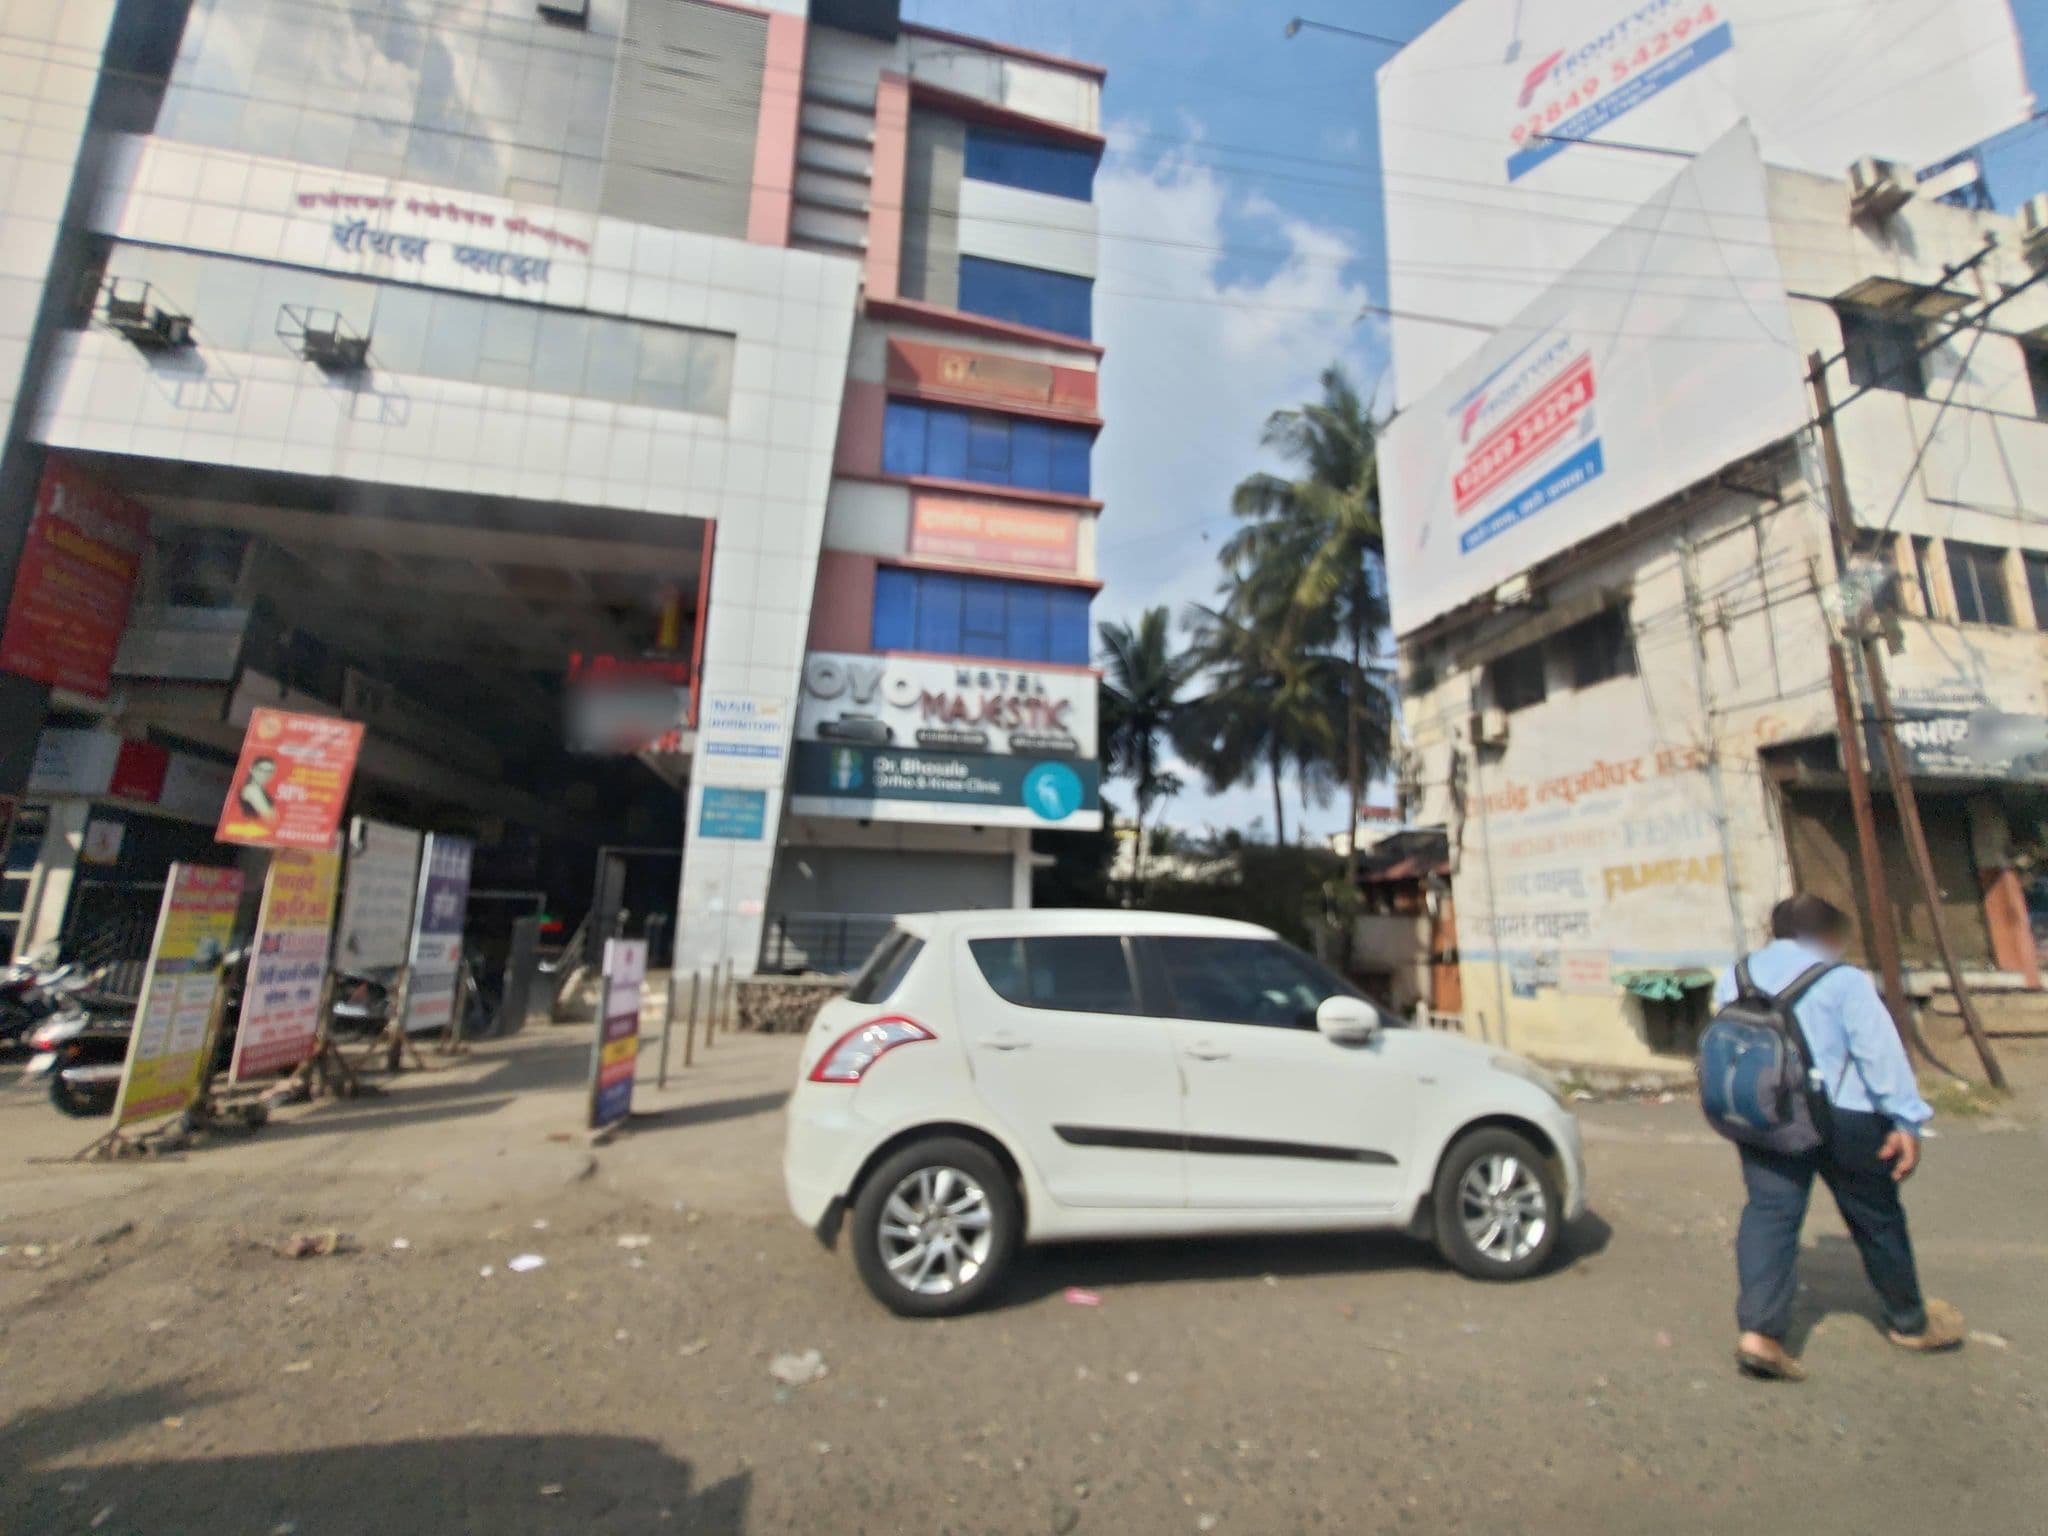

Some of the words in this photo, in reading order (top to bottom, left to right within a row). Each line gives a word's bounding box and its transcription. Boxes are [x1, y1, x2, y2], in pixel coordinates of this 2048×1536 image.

[1510, 76, 1600, 144] 92849
[1611, 3, 1716, 82] 54294
[805, 660, 922, 708] OYO
[955, 669, 1045, 696] HOTEL
[920, 689, 1070, 731] MAJESTIC
